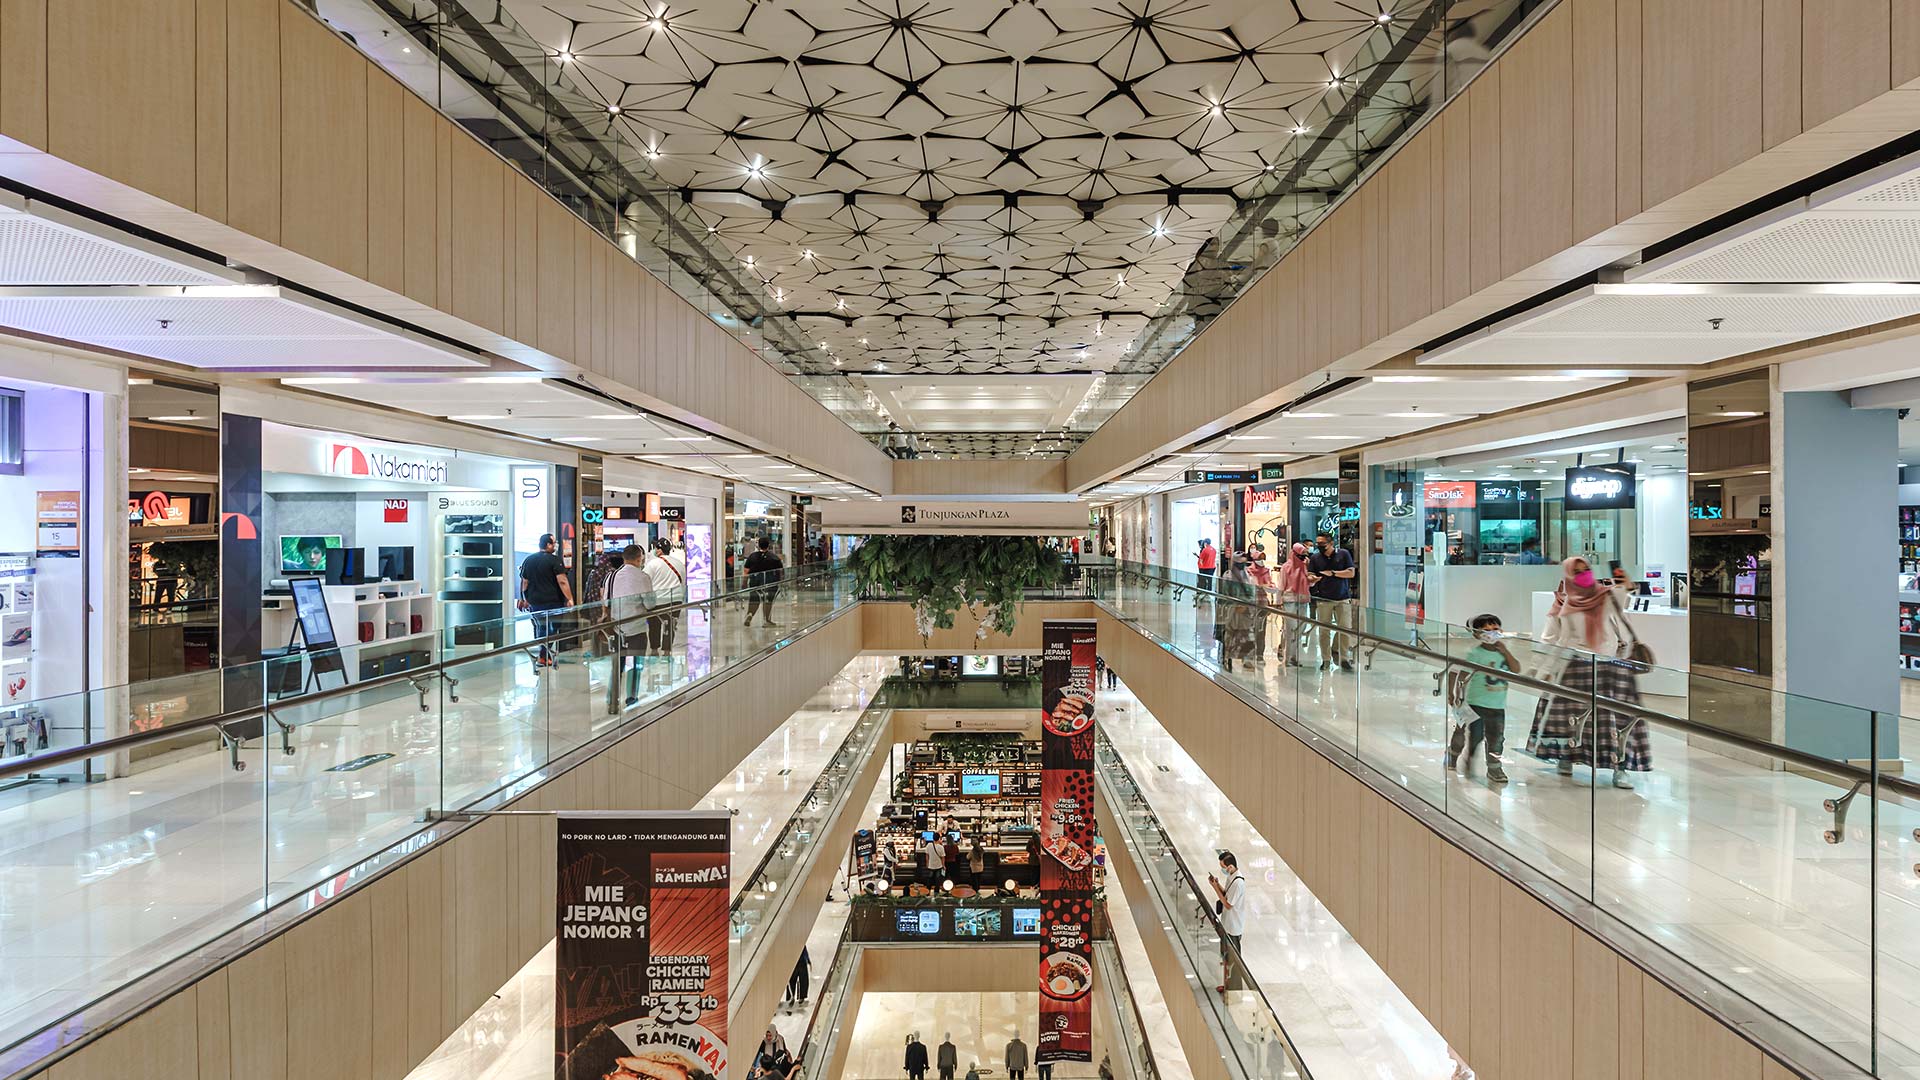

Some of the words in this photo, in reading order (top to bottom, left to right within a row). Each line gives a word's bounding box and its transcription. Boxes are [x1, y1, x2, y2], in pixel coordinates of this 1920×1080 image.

[371, 453, 448, 483] Nakamichi
[1197, 472, 1204, 481] 3
[1429, 490, 1465, 499] SanDisk
[384, 500, 407, 510] NAD
[52, 532, 60, 540] 15
[585, 886, 624, 902] MIE
[563, 906, 648, 922] JEPANG
[564, 925, 632, 938] NOMOR
[637, 925, 646, 938] 1
[650, 956, 709, 964] LEGENDARY
[646, 966, 710, 977] CHICKEN
[652, 979, 704, 990] RAMEN
[1040, 1034, 1060, 1042] NOW!
